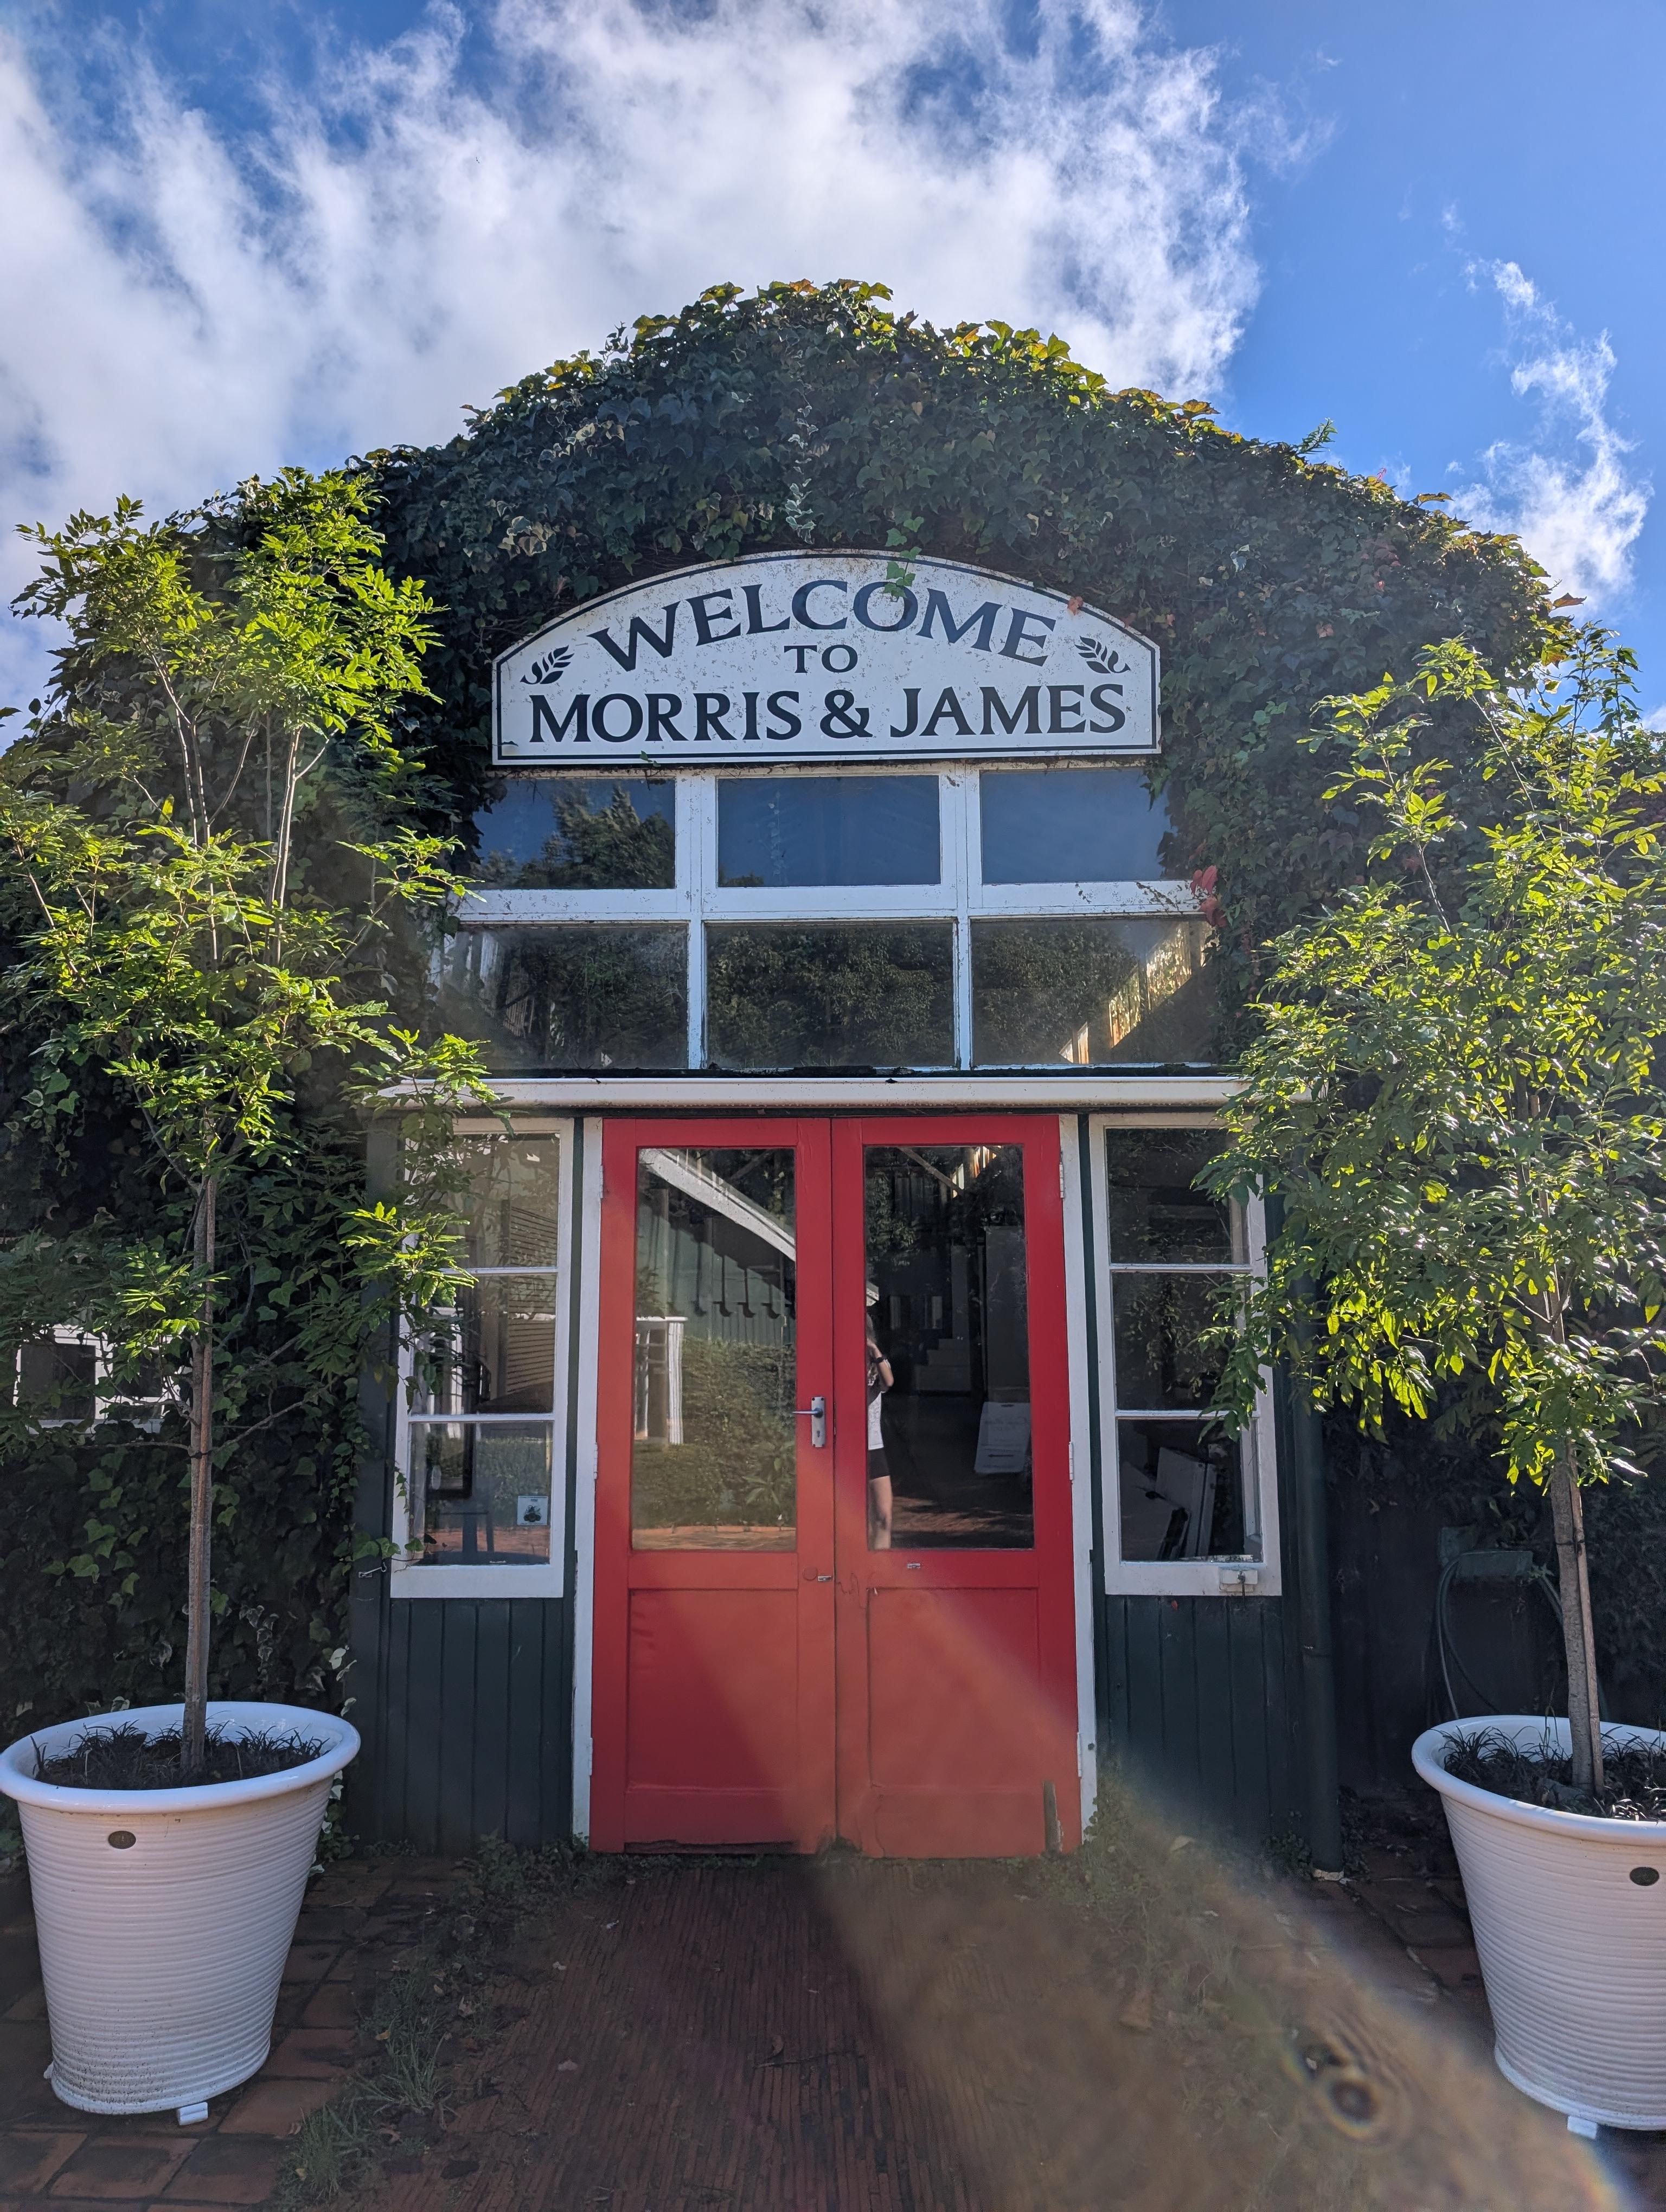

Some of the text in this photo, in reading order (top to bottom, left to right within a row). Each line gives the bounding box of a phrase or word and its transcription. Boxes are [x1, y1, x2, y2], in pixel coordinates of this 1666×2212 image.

[587, 579, 1057, 673] WELCOME
[784, 644, 858, 673] TO
[529, 684, 1125, 743] MORRIS & JAMES
